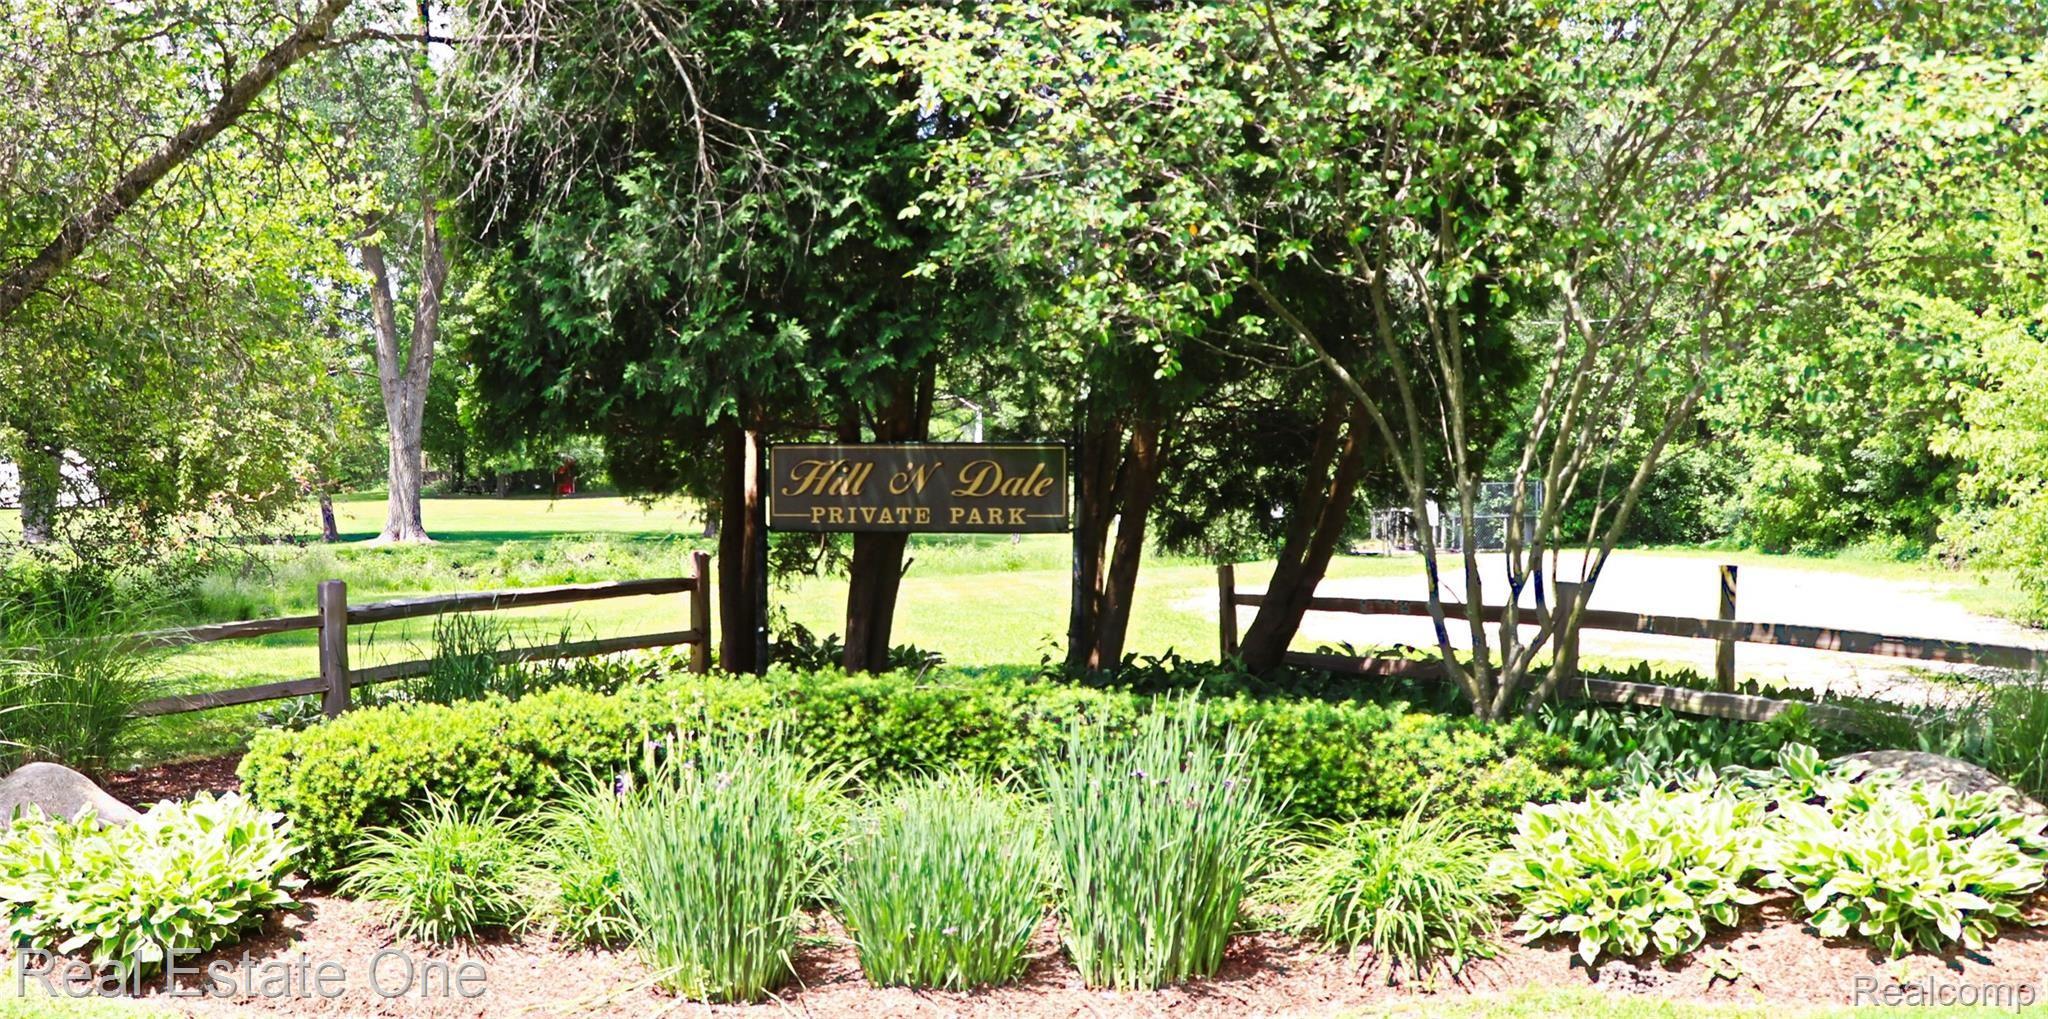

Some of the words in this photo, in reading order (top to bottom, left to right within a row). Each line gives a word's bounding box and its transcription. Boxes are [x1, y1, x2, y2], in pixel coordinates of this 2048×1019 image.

[782, 458, 874, 497] Hill
[951, 459, 1054, 497] Dale
[810, 506, 931, 524] PRIVATE
[950, 507, 1027, 525] PARK
